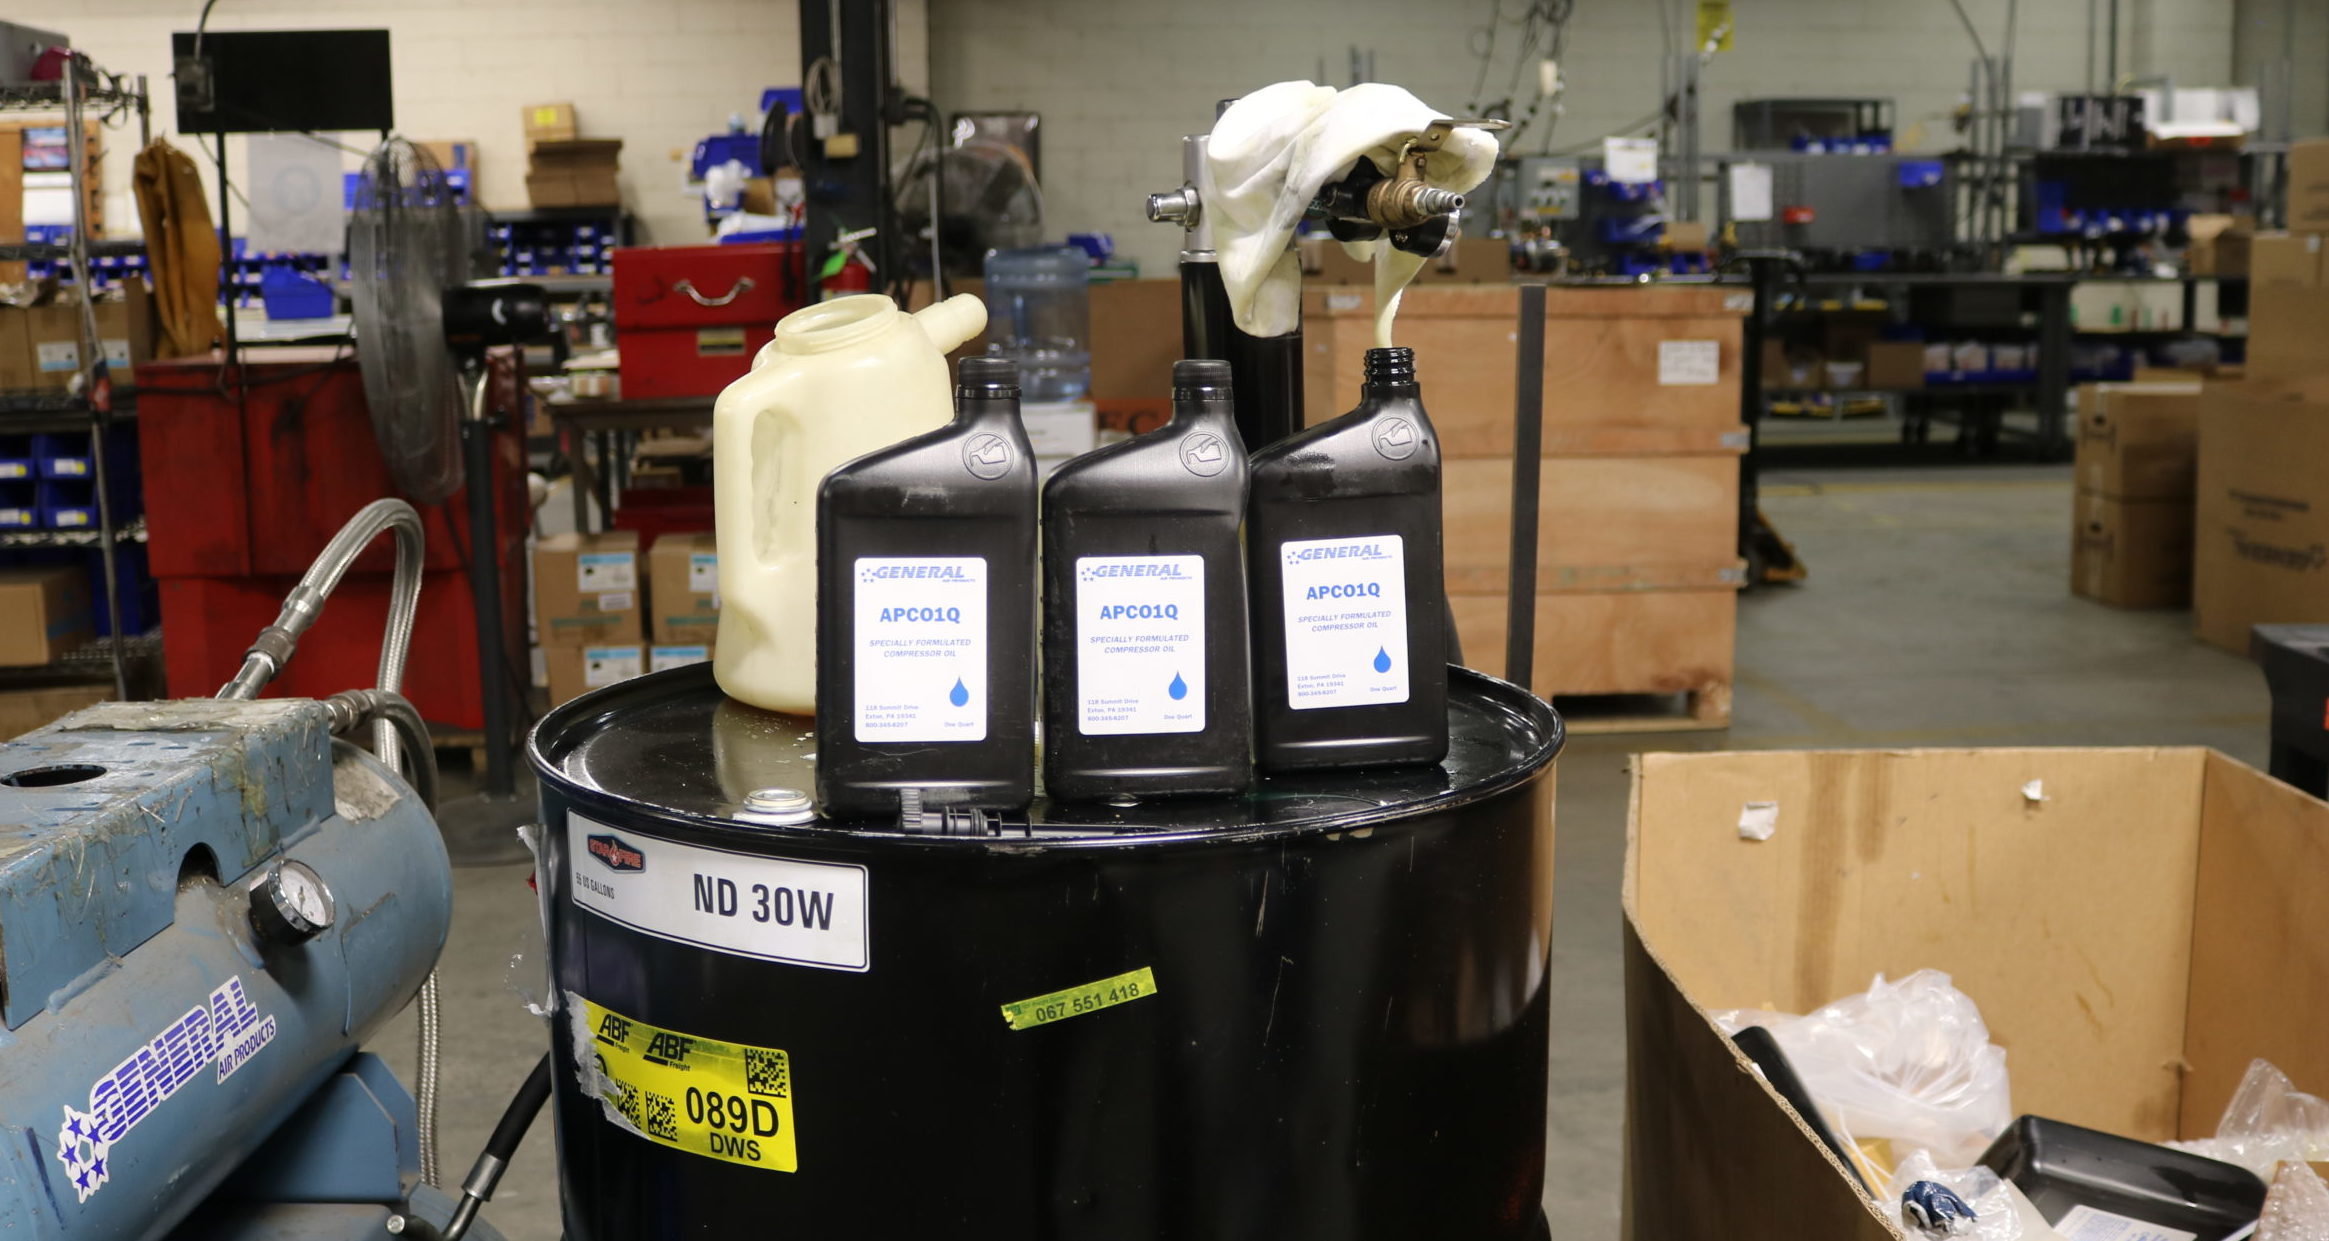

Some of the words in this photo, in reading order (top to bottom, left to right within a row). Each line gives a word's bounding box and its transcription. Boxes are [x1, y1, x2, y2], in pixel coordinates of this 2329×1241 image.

[1300, 544, 1382, 560] GENERAL
[876, 566, 965, 579] GENERAL
[1095, 564, 1182, 578] GENERAL
[1297, 614, 1339, 623] SPECIALLY
[1340, 610, 1392, 619] FORMULATED
[1312, 622, 1365, 632] COMPRESSOR
[869, 639, 912, 647] SPECIALLY
[1090, 636, 1132, 644] SPECIALLY
[1135, 634, 1190, 642] FORMULATED
[583, 875, 590, 889] US
[590, 879, 615, 899] GALLONS
[693, 873, 738, 917] ND
[752, 883, 834, 931] 30W
[1036, 1002, 1066, 1022] 067
[1073, 993, 1102, 1013] 551
[1109, 983, 1139, 1003] 418
[598, 1013, 632, 1043] ABF
[218, 1059, 233, 1081] AIR
[234, 1019, 275, 1066] PRODUCTS
[646, 1032, 694, 1061] ABF
[93, 979, 257, 1141] GENERAL
[669, 1060, 691, 1072] Freight
[685, 1086, 779, 1138] 089D
[710, 1132, 761, 1162] DWS
